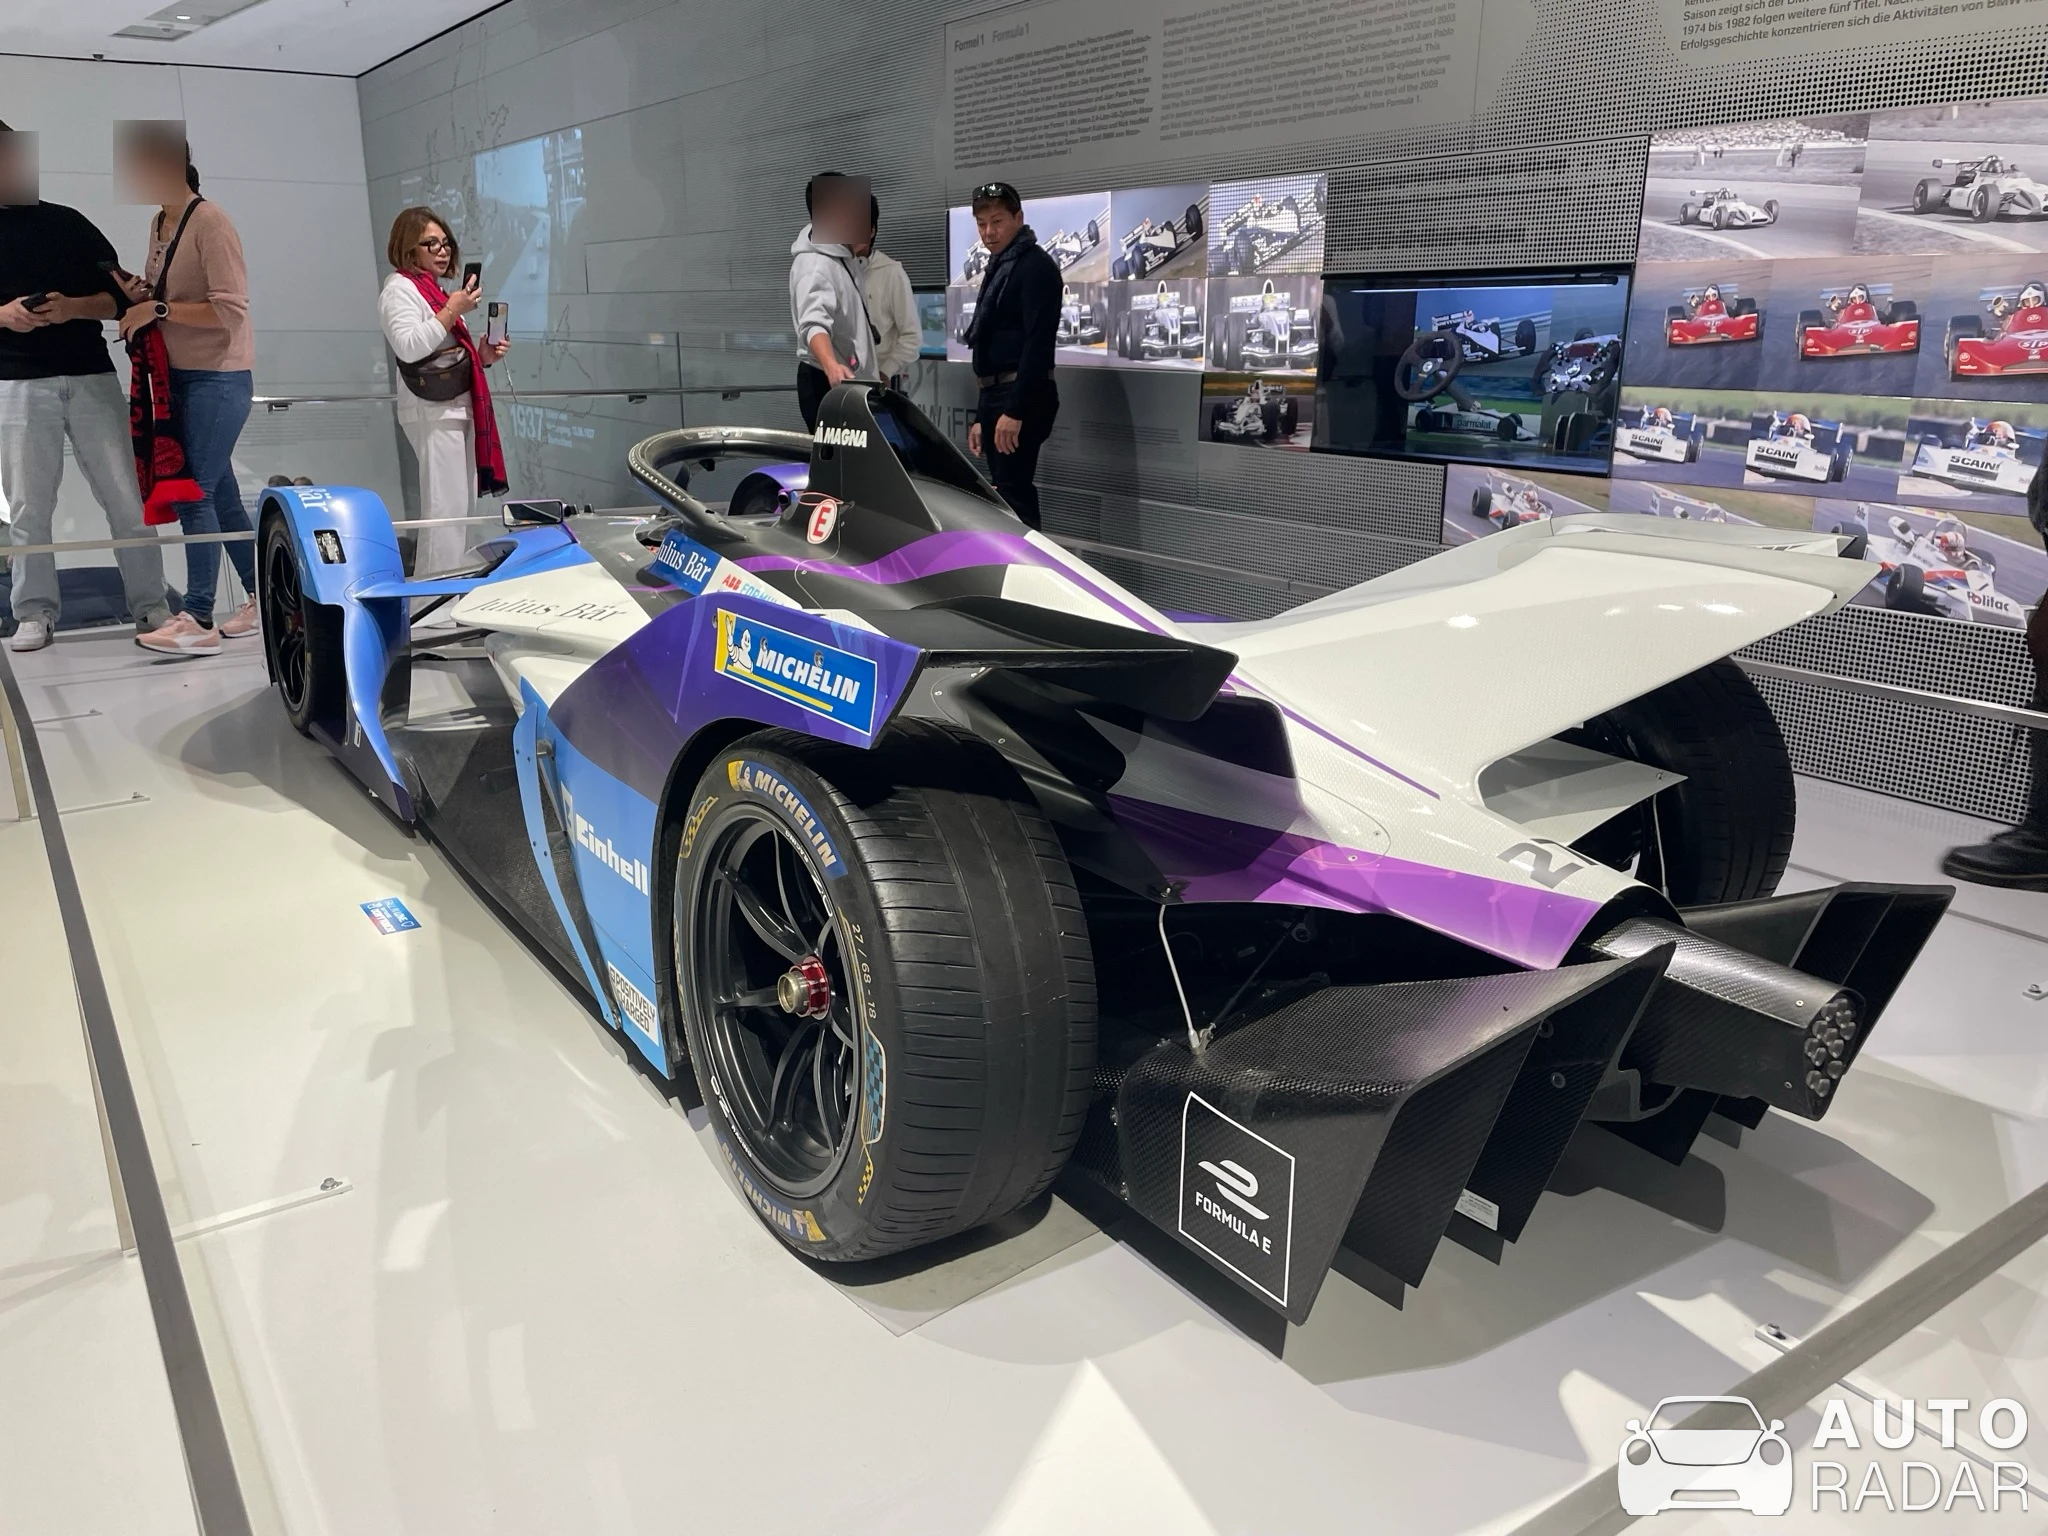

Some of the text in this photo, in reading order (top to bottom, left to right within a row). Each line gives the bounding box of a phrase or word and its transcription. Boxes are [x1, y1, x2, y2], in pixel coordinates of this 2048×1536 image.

[1360, 18, 1373, 28] The
[1448, 1, 1456, 10] to
[1437, 13, 1456, 25] 2003
[1683, 8, 1716, 21] Saison
[1718, 5, 1743, 19] zeigt
[1744, 1, 1766, 11] sich
[1683, 22, 1706, 35] 1974
[1708, 20, 1723, 32] bis
[1726, 16, 1751, 29] 1982
[1752, 11, 1786, 26] folgen
[1787, 7, 1827, 20] weitere
[1828, 2, 1851, 15] fünf
[1853, 0, 1881, 11] Titel.
[954, 35, 979, 52] Formel
[992, 24, 1024, 43] Formula
[1434, 27, 1455, 39] Pablo
[1680, 30, 1769, 51] Erfolgsgeschichte
[1771, 19, 1845, 38] konzentrieren
[1847, 15, 1870, 28] sich
[1873, 12, 1890, 24] die
[1892, 4, 1958, 22] Aktivitäten
[1961, 1, 1984, 13] von
[1424, 42, 1441, 53] This
[2022, 339, 2048, 348] STP
[510, 404, 543, 441] 1937
[1456, 417, 1491, 430] parmalat
[823, 427, 867, 448] MAGNA
[812, 506, 831, 537] E
[658, 540, 712, 583] ulius Bär
[722, 573, 742, 591] ABB
[462, 598, 627, 621] Julius Bär
[755, 648, 861, 705] MICHELIN
[754, 769, 837, 868] MICHELIN
[576, 813, 648, 897] Einhell
[615, 971, 656, 1023] POSITIVELY
[721, 1142, 791, 1231] MICHELIN
[1195, 1191, 1272, 1255] FORMULA E
